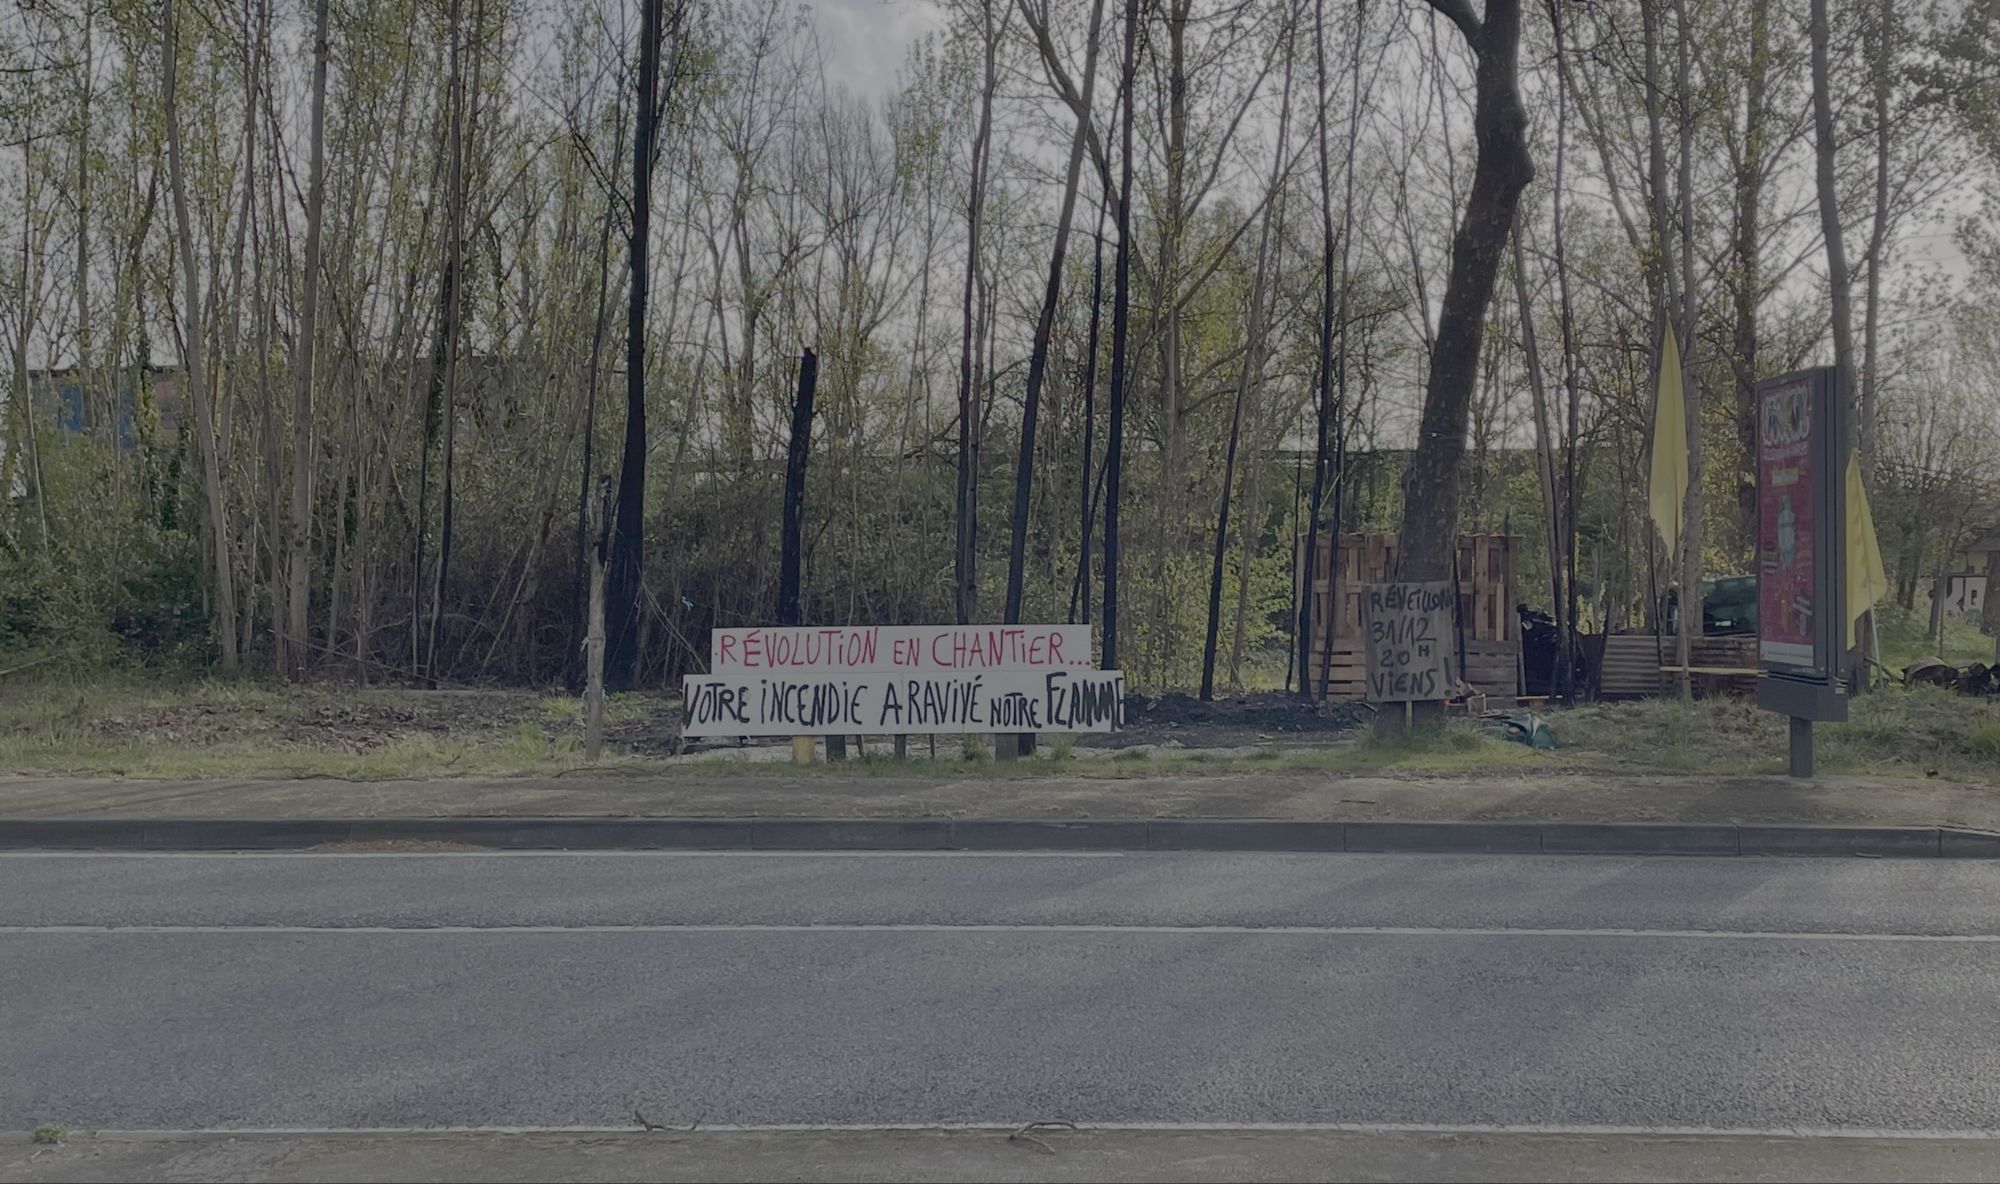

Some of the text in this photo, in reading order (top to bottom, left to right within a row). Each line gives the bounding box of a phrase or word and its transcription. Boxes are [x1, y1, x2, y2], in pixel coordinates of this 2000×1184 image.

[1372, 615, 1437, 646] 31/12
[894, 638, 919, 665] EN
[683, 682, 750, 729] VOTRE
[990, 692, 1042, 728] NOTRE
[1046, 671, 1124, 732] FLAMME
